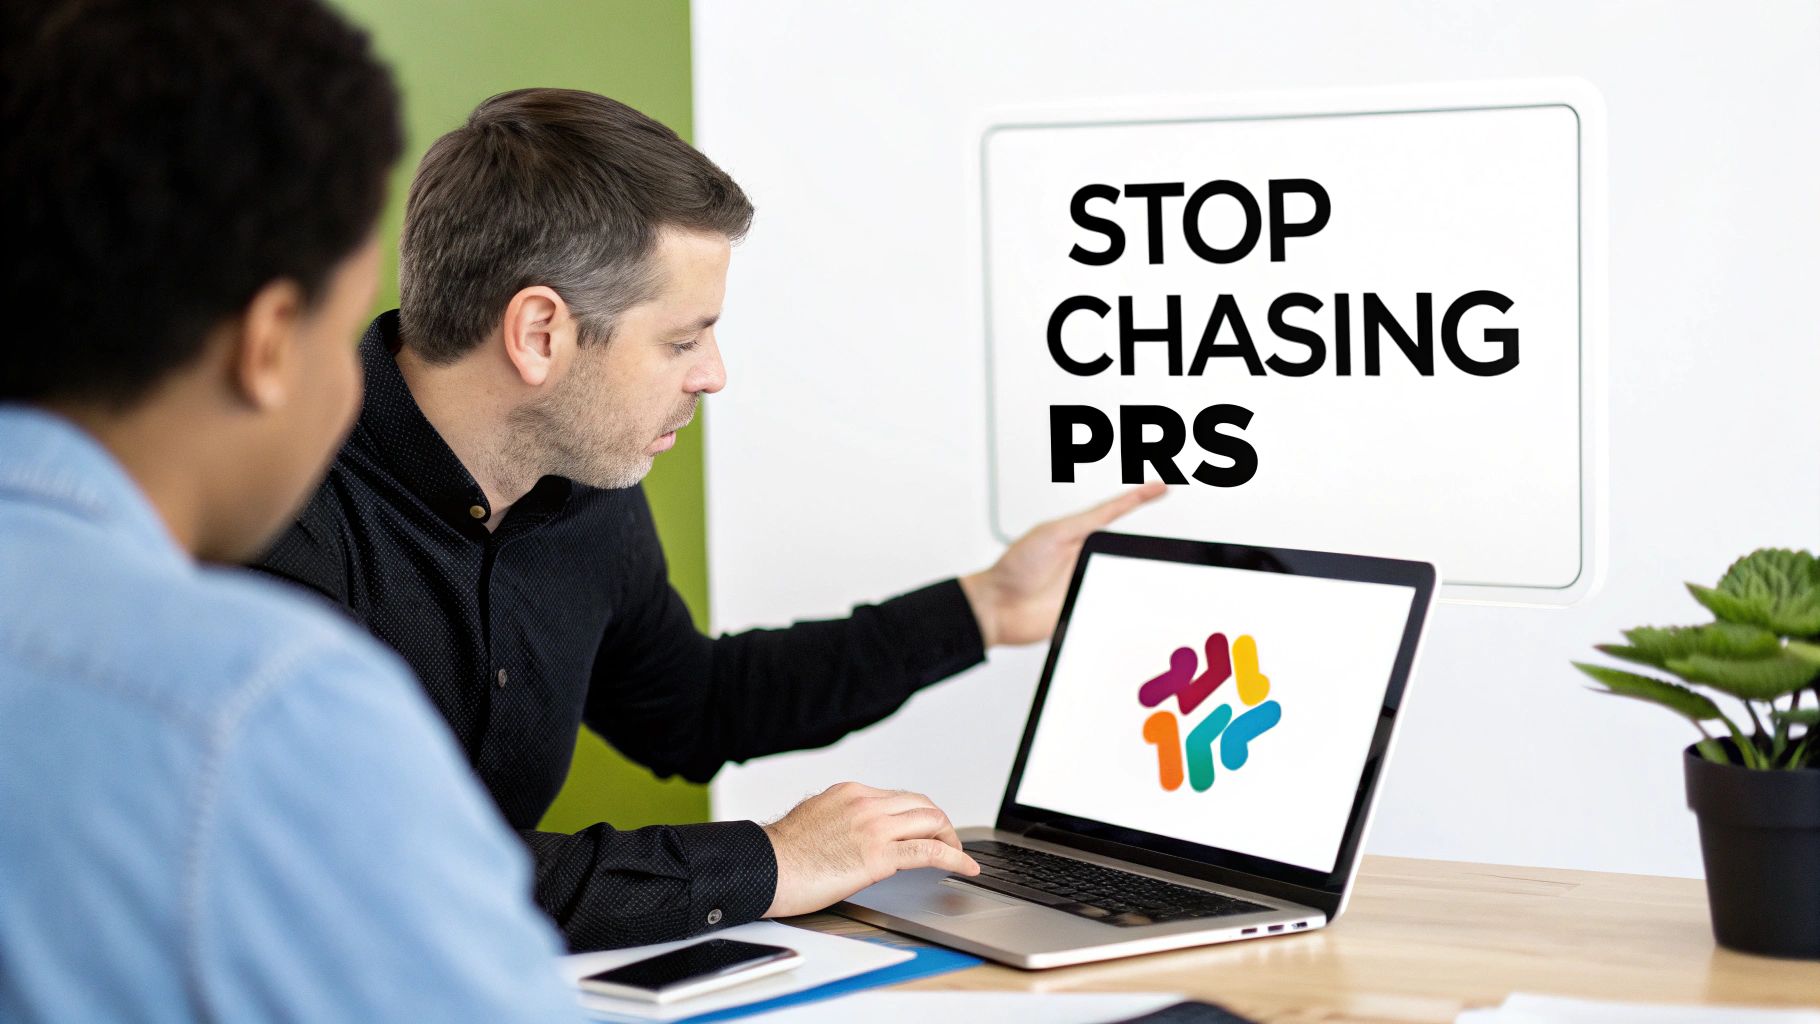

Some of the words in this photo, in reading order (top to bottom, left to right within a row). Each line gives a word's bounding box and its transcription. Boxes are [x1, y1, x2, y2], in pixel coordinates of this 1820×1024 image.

[1068, 178, 1332, 266] STOP
[1046, 290, 1520, 377] CHASING
[1049, 404, 1258, 487] PRS
